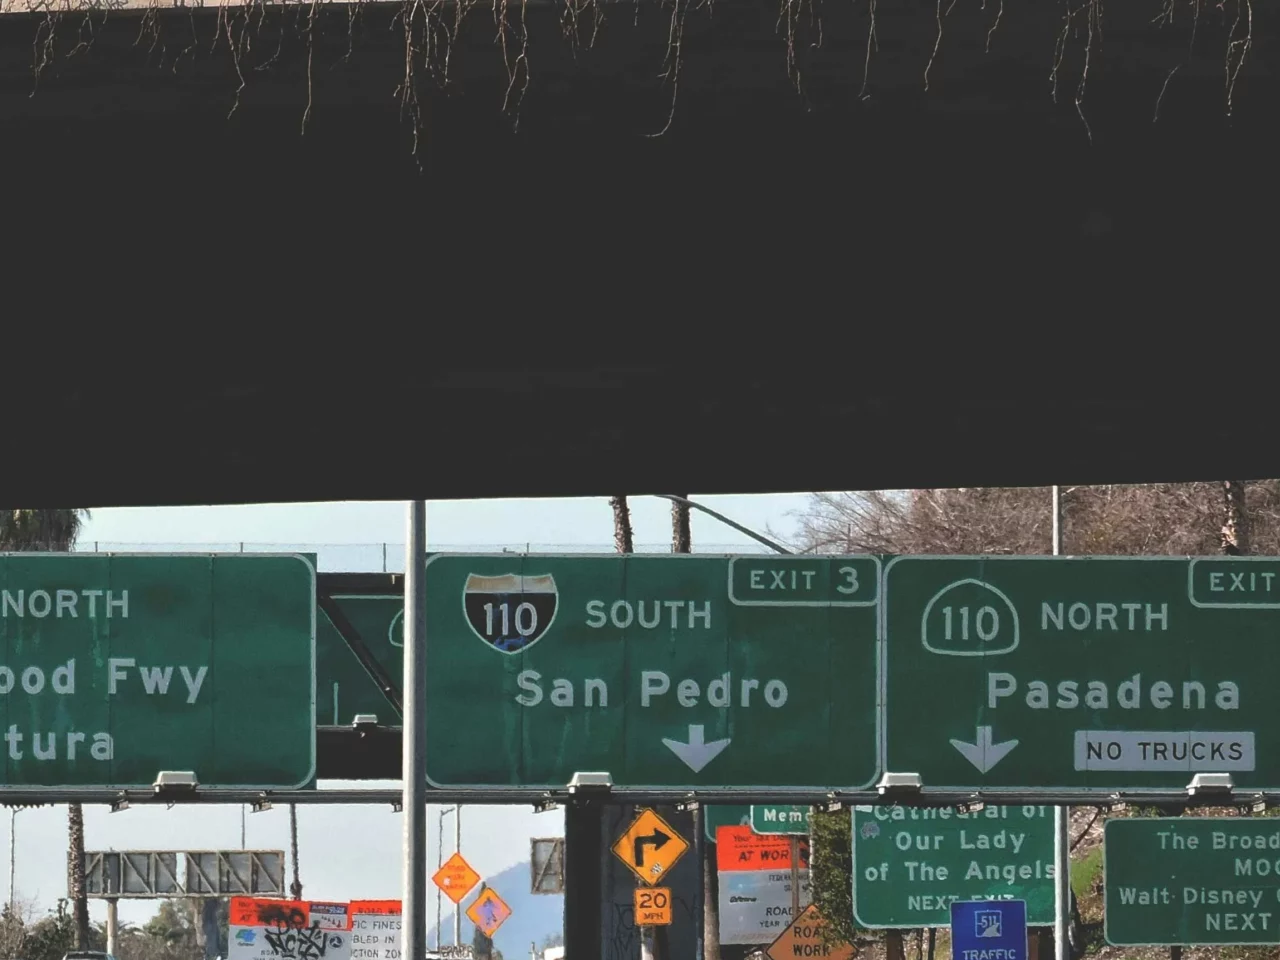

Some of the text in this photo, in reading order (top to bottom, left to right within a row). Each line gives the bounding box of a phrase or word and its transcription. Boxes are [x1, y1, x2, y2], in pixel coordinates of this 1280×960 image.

[750, 565, 859, 594] EXIT 3
[1208, 570, 1276, 592] EXIT
[2, 589, 129, 619] NORTH
[483, 599, 712, 636] 110 SOUTH
[942, 602, 1168, 641] 110 NORTH
[107, 657, 209, 704] Fwy
[515, 669, 790, 708] San Pedro
[987, 672, 1240, 710] Pasadena
[1086, 740, 1245, 761] NO TRUCKS
[895, 830, 1026, 853] Our Lady
[1156, 832, 1200, 850] The
[739, 850, 790, 862] AT WOR
[864, 860, 1056, 885] of The Angels
[639, 893, 667, 908] 20
[908, 896, 960, 911] NEXT
[1119, 887, 1170, 905] Walt
[1183, 887, 1264, 909] Disney
[373, 920, 402, 930] FINES
[643, 912, 664, 920] MPH
[1205, 912, 1272, 931] NEXT
[384, 936, 395, 944] IN
[793, 944, 831, 957] WORK
[962, 949, 1017, 960] TRAFFIC
